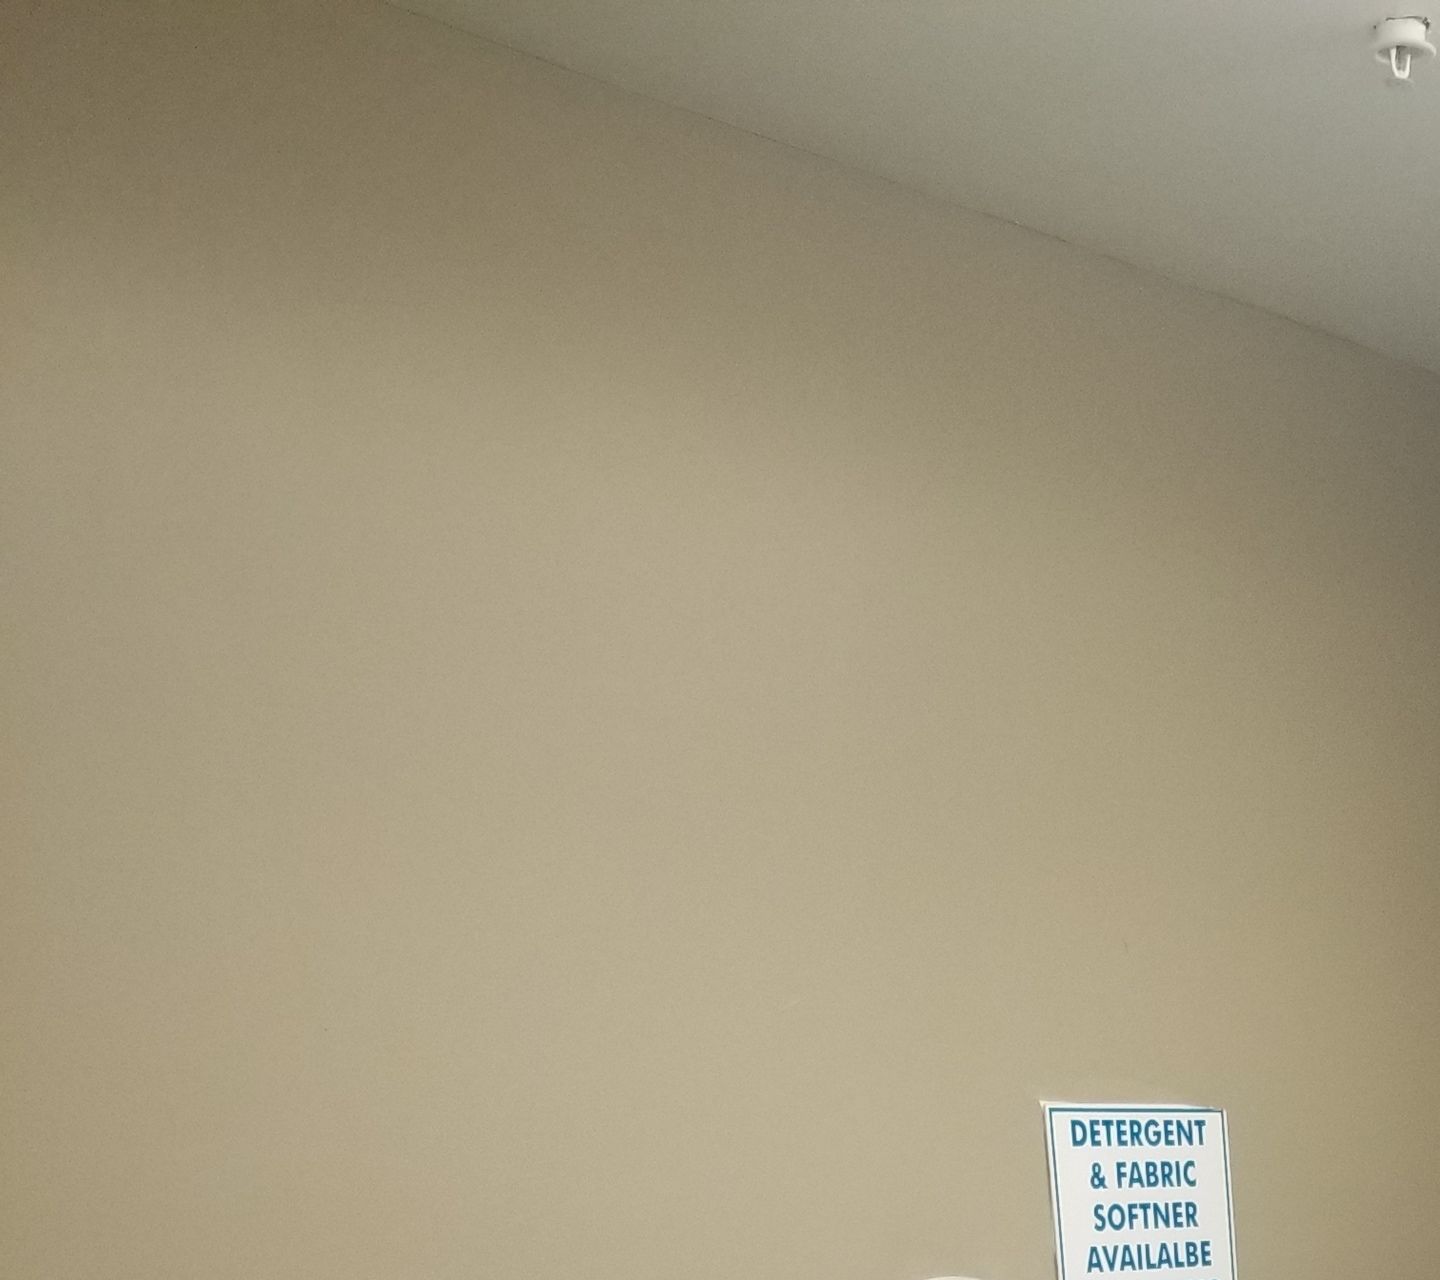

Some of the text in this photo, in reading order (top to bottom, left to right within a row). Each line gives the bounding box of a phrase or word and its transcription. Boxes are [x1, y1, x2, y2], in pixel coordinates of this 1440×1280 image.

[1071, 1119, 1206, 1147] DETERGENT
[1090, 1160, 1197, 1189] & FABRIC
[1094, 1202, 1199, 1231] SOFTNER
[1087, 1240, 1212, 1273] AVAILALBE
